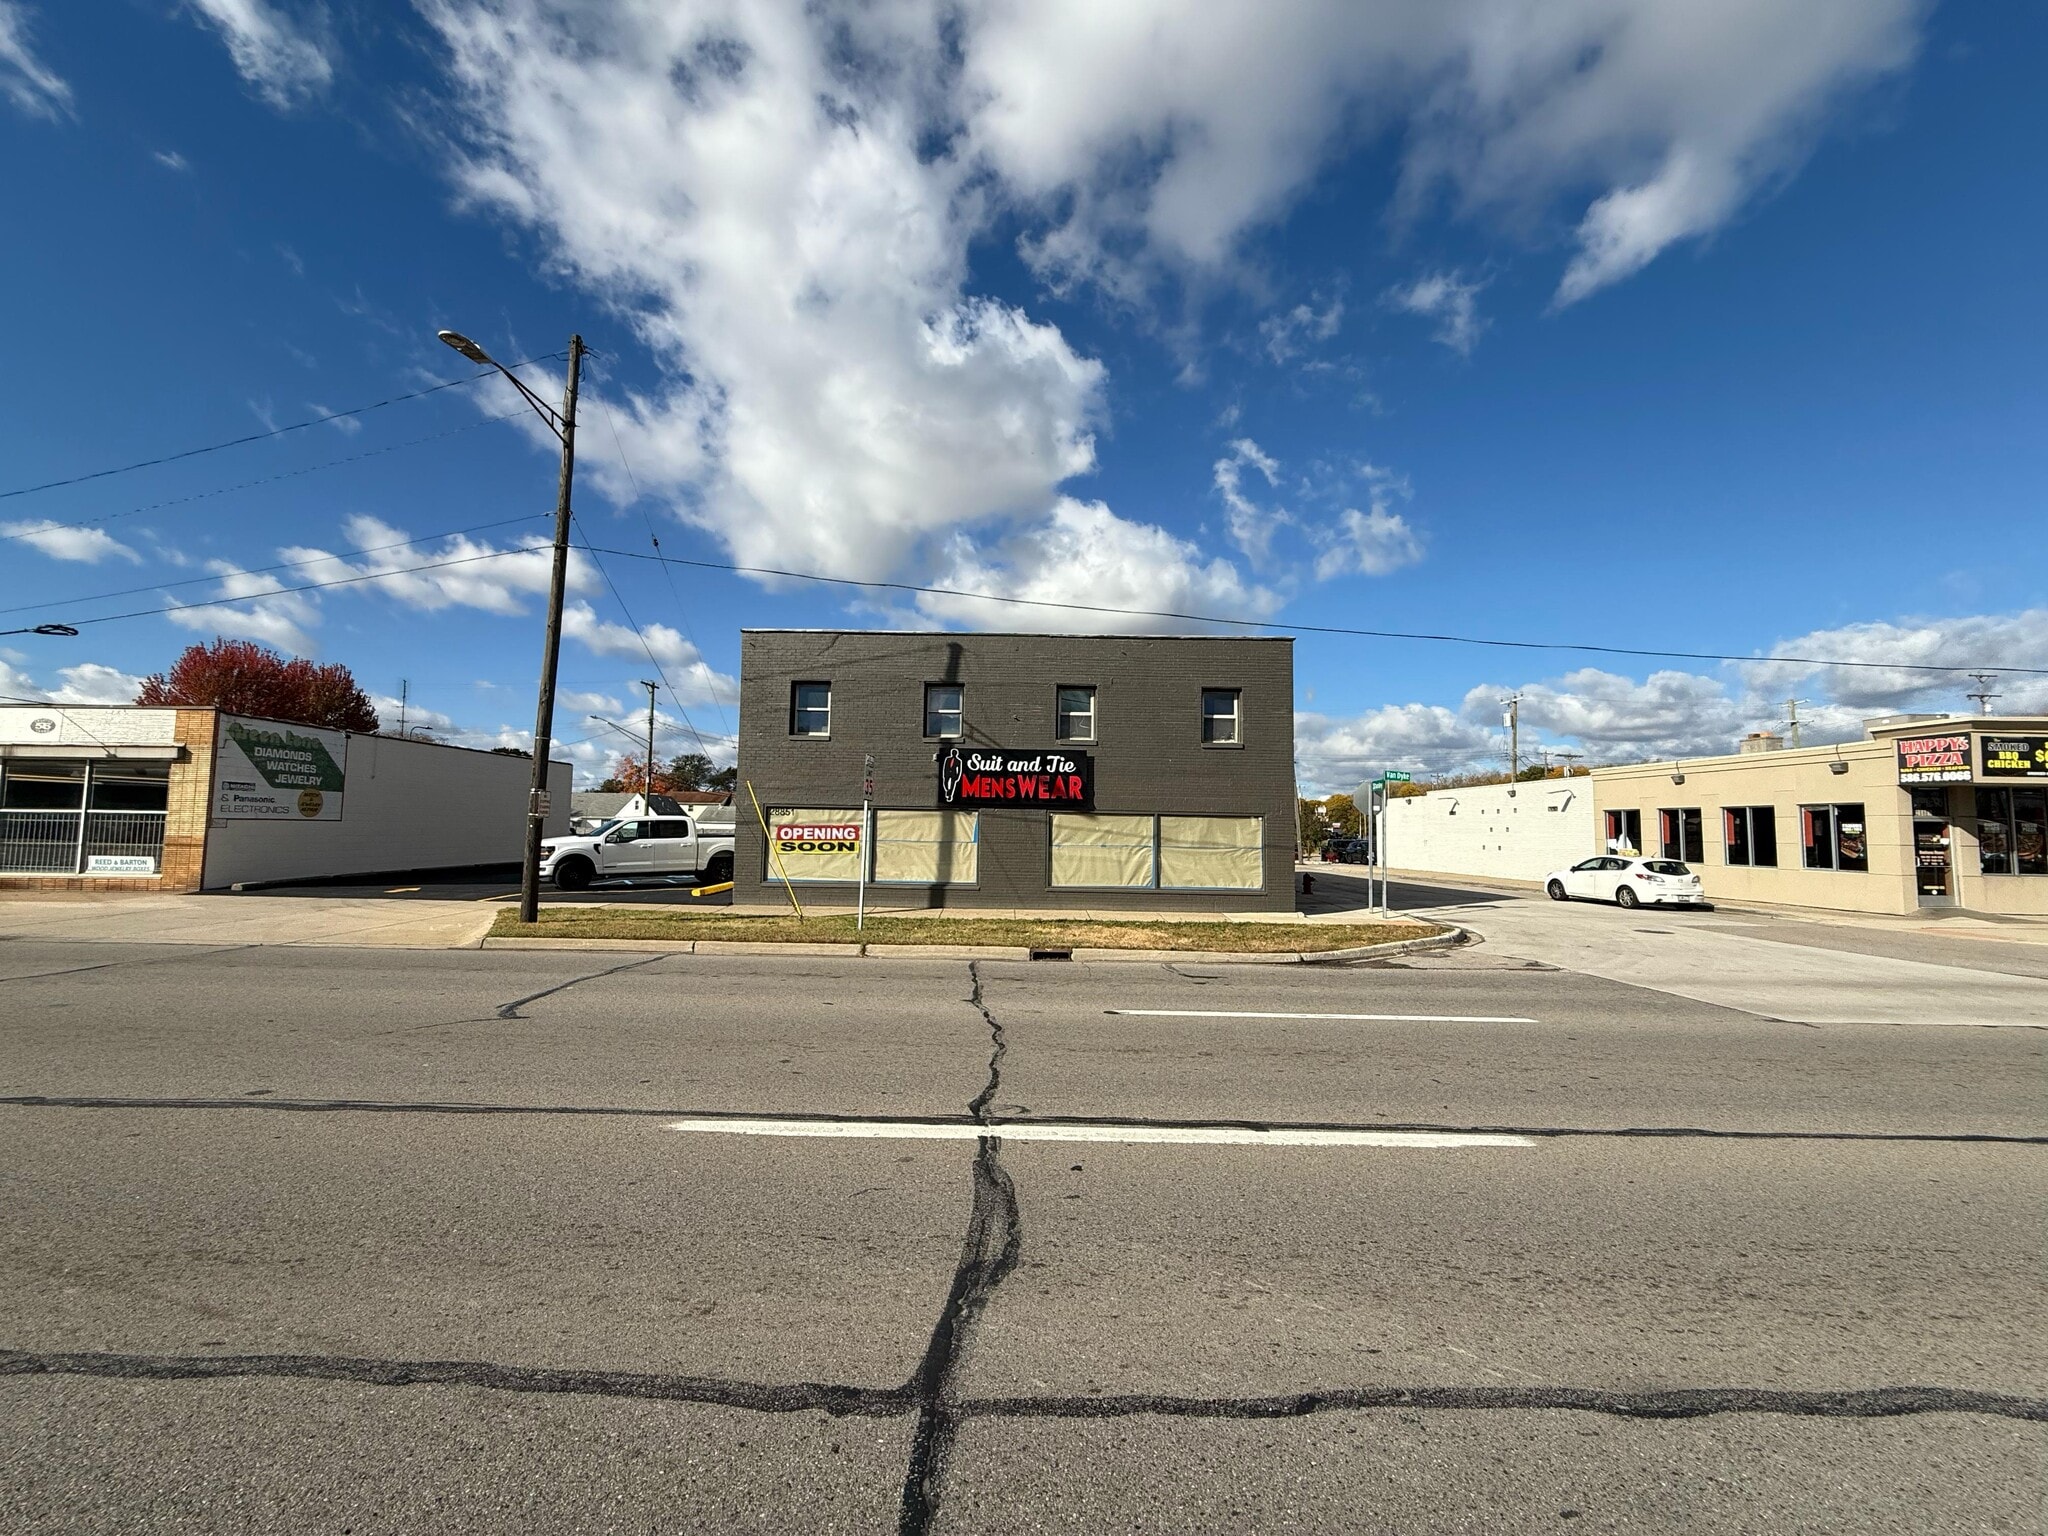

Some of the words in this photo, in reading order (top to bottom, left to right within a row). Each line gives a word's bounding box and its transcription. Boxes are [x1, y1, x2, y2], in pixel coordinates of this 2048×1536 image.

[1987, 742, 2030, 752] SMOKED
[254, 747, 313, 762] DIAMONDS
[1905, 752, 1964, 767] PIZZA
[1998, 751, 2019, 761] BBQ
[266, 761, 317, 774] WATCHES
[967, 753, 1003, 771] Suit
[1007, 756, 1042, 772] and
[1046, 755, 1077, 773] Tie
[1987, 759, 2031, 769] CHICKEN
[275, 774, 322, 786] JEWELRY
[1386, 771, 1397, 779] Van
[1396, 772, 1410, 781] Dyke
[961, 773, 1084, 800] MENSWEAR
[221, 793, 229, 802] &
[233, 794, 276, 804] Panasonic
[220, 804, 290, 815] ELECTRONICS
[770, 807, 795, 816] 28851
[780, 827, 856, 840] OPENING
[780, 841, 855, 852] SOON
